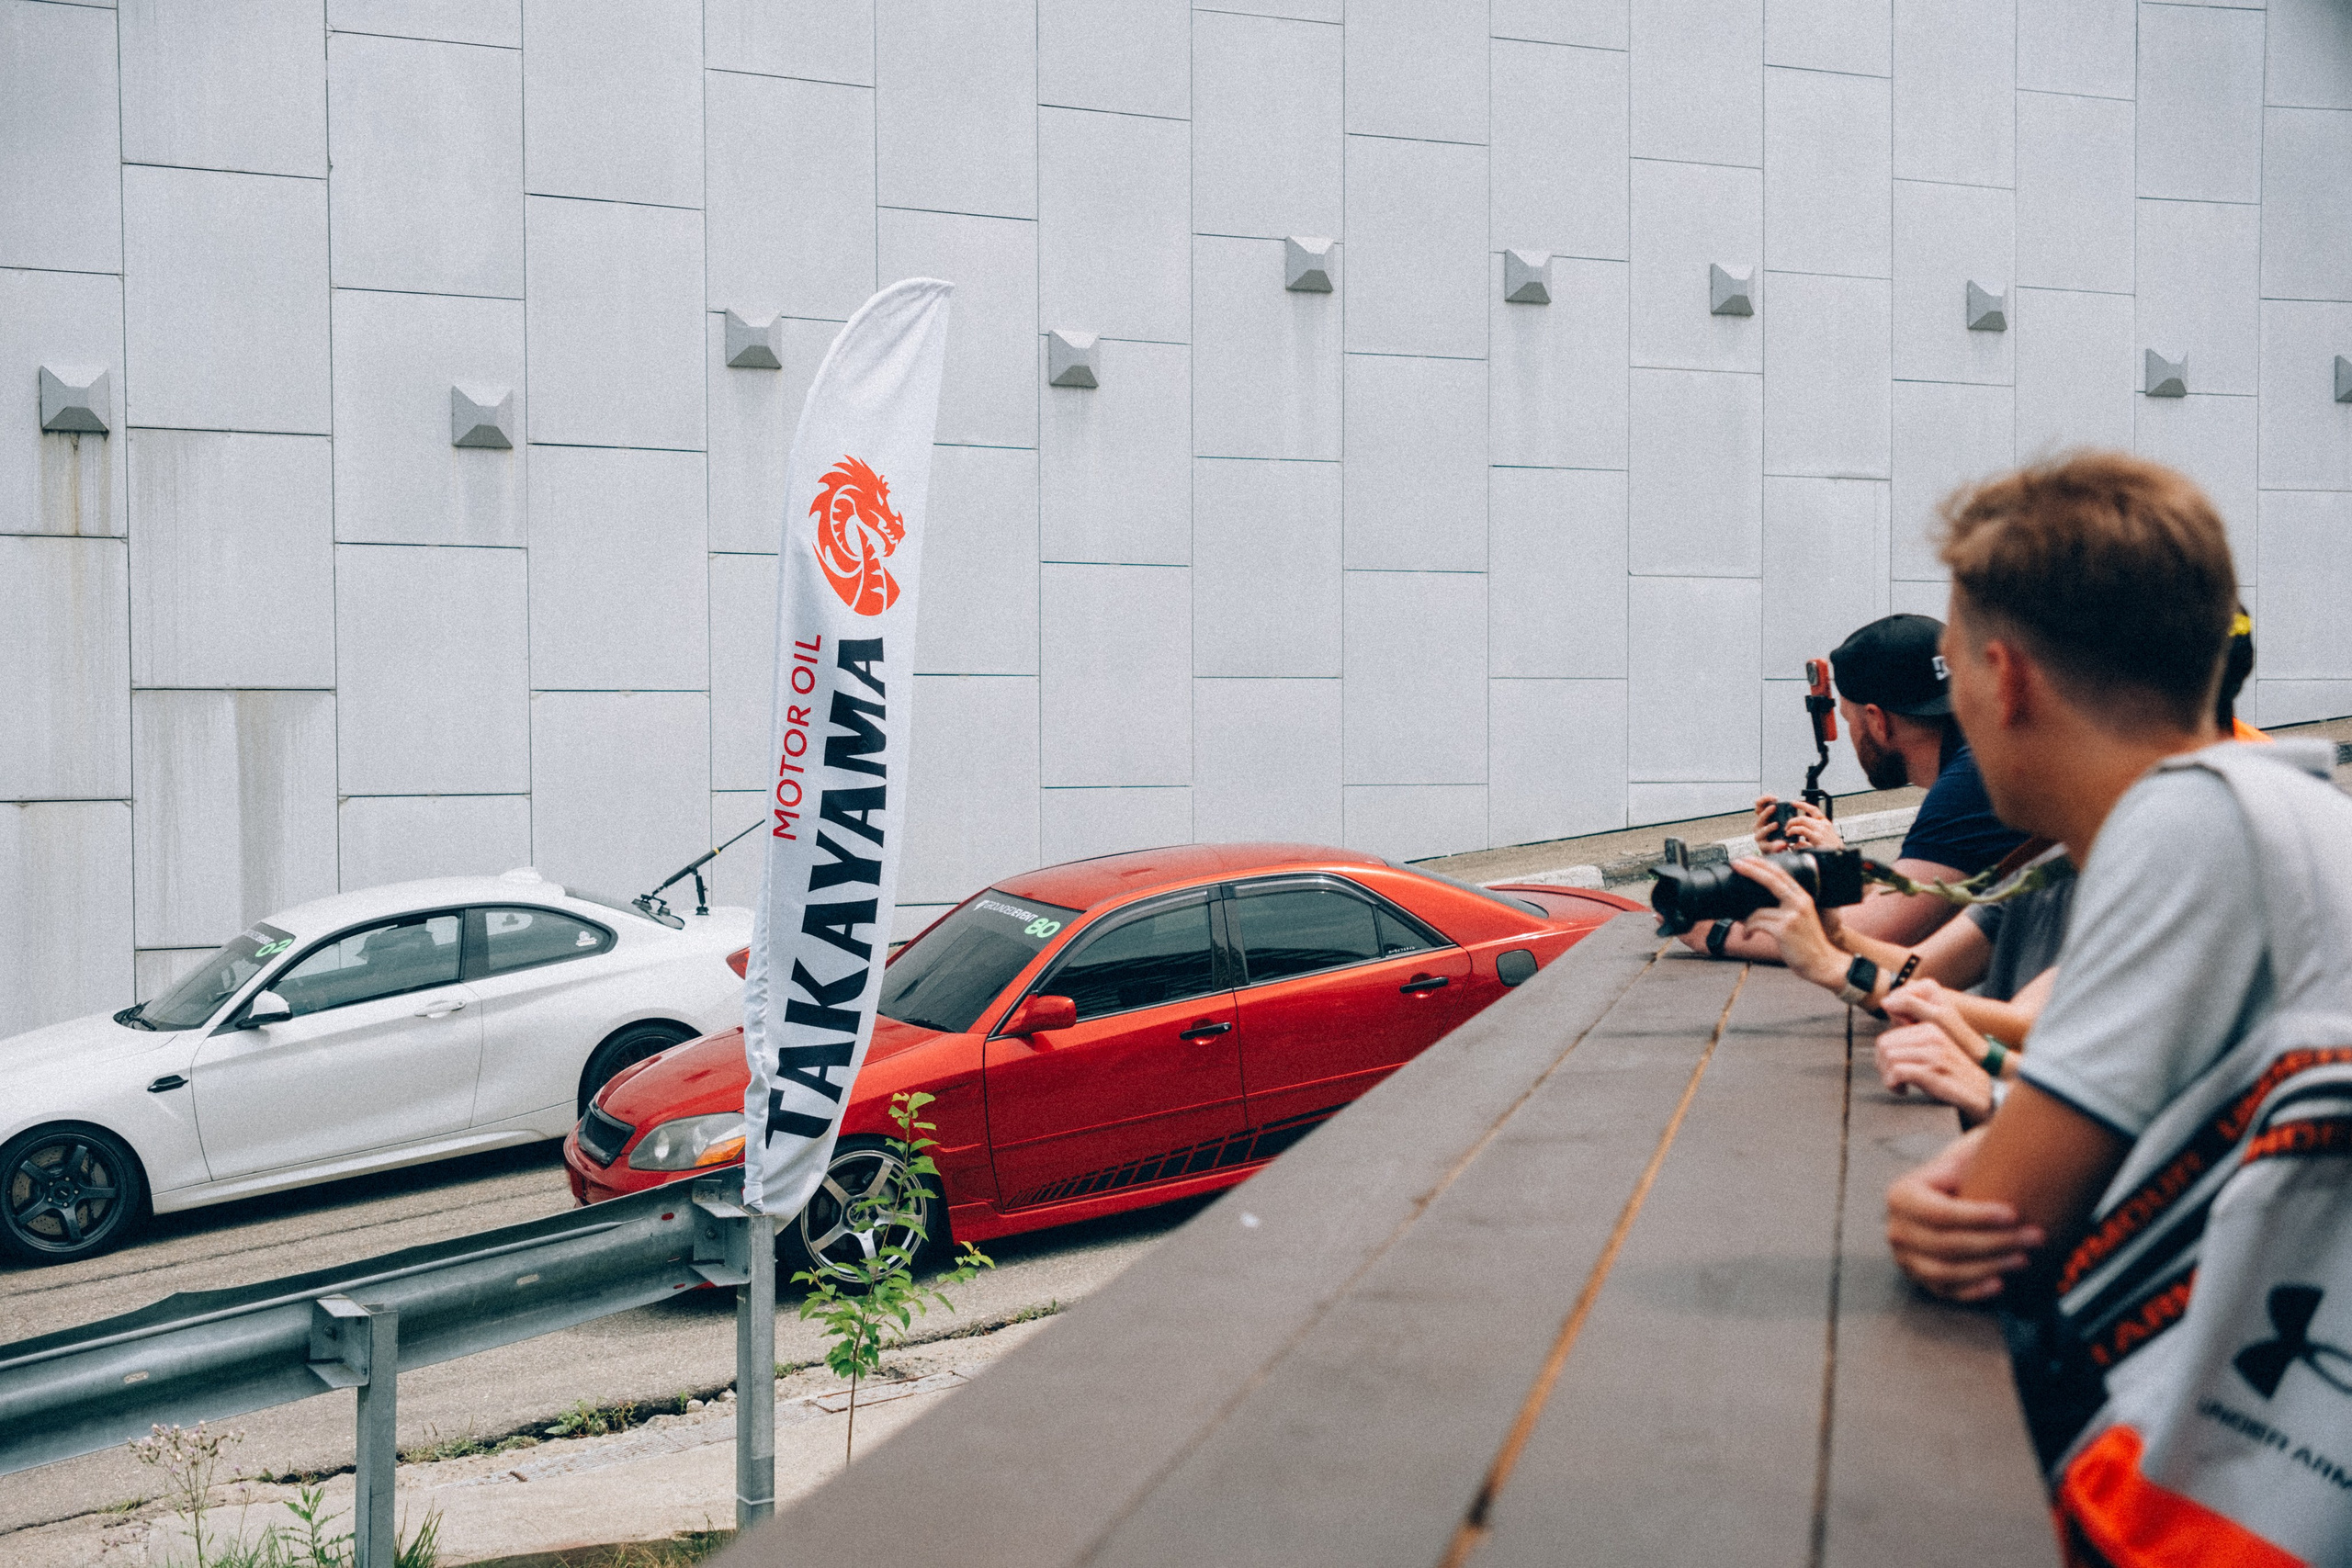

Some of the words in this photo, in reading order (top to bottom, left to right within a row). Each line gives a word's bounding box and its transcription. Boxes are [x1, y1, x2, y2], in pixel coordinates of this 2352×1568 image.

[791, 634, 821, 694] OIL
[773, 705, 811, 840] MOTOR
[765, 637, 887, 1149] TAKAYAMA
[254, 938, 293, 957] 02
[1024, 918, 1060, 938] 80
